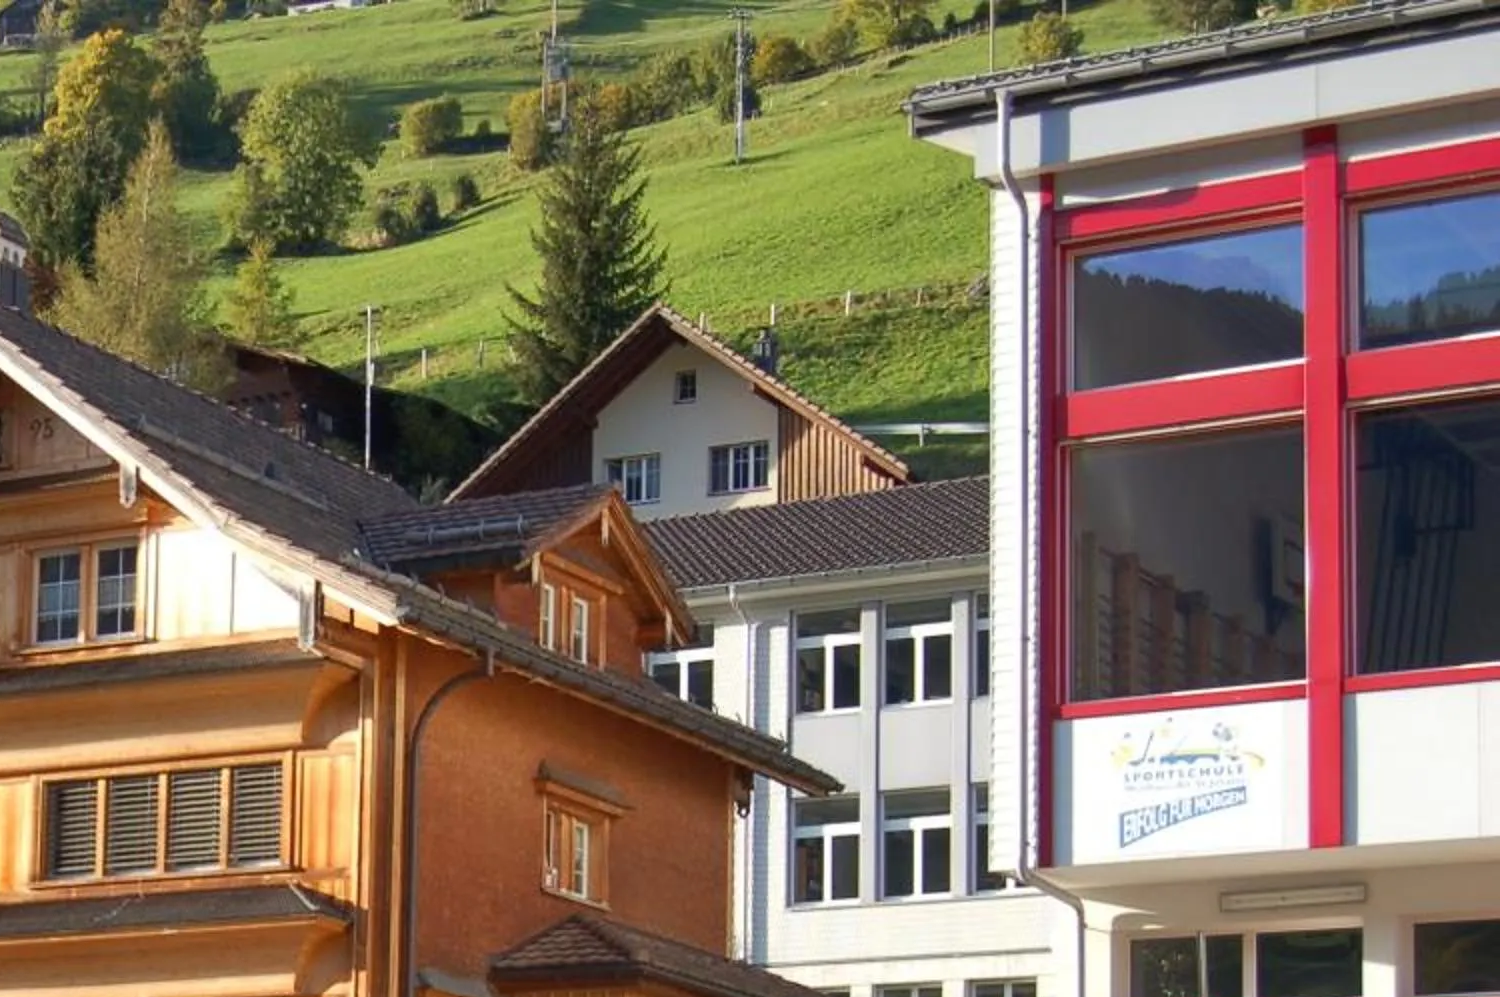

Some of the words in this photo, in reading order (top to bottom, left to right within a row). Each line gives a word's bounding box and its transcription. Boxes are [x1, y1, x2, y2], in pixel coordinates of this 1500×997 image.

[1124, 764, 1244, 783] SPORTSCHULE
[1124, 801, 1168, 842] ERFOLG
[1195, 791, 1244, 813] MORGEN
